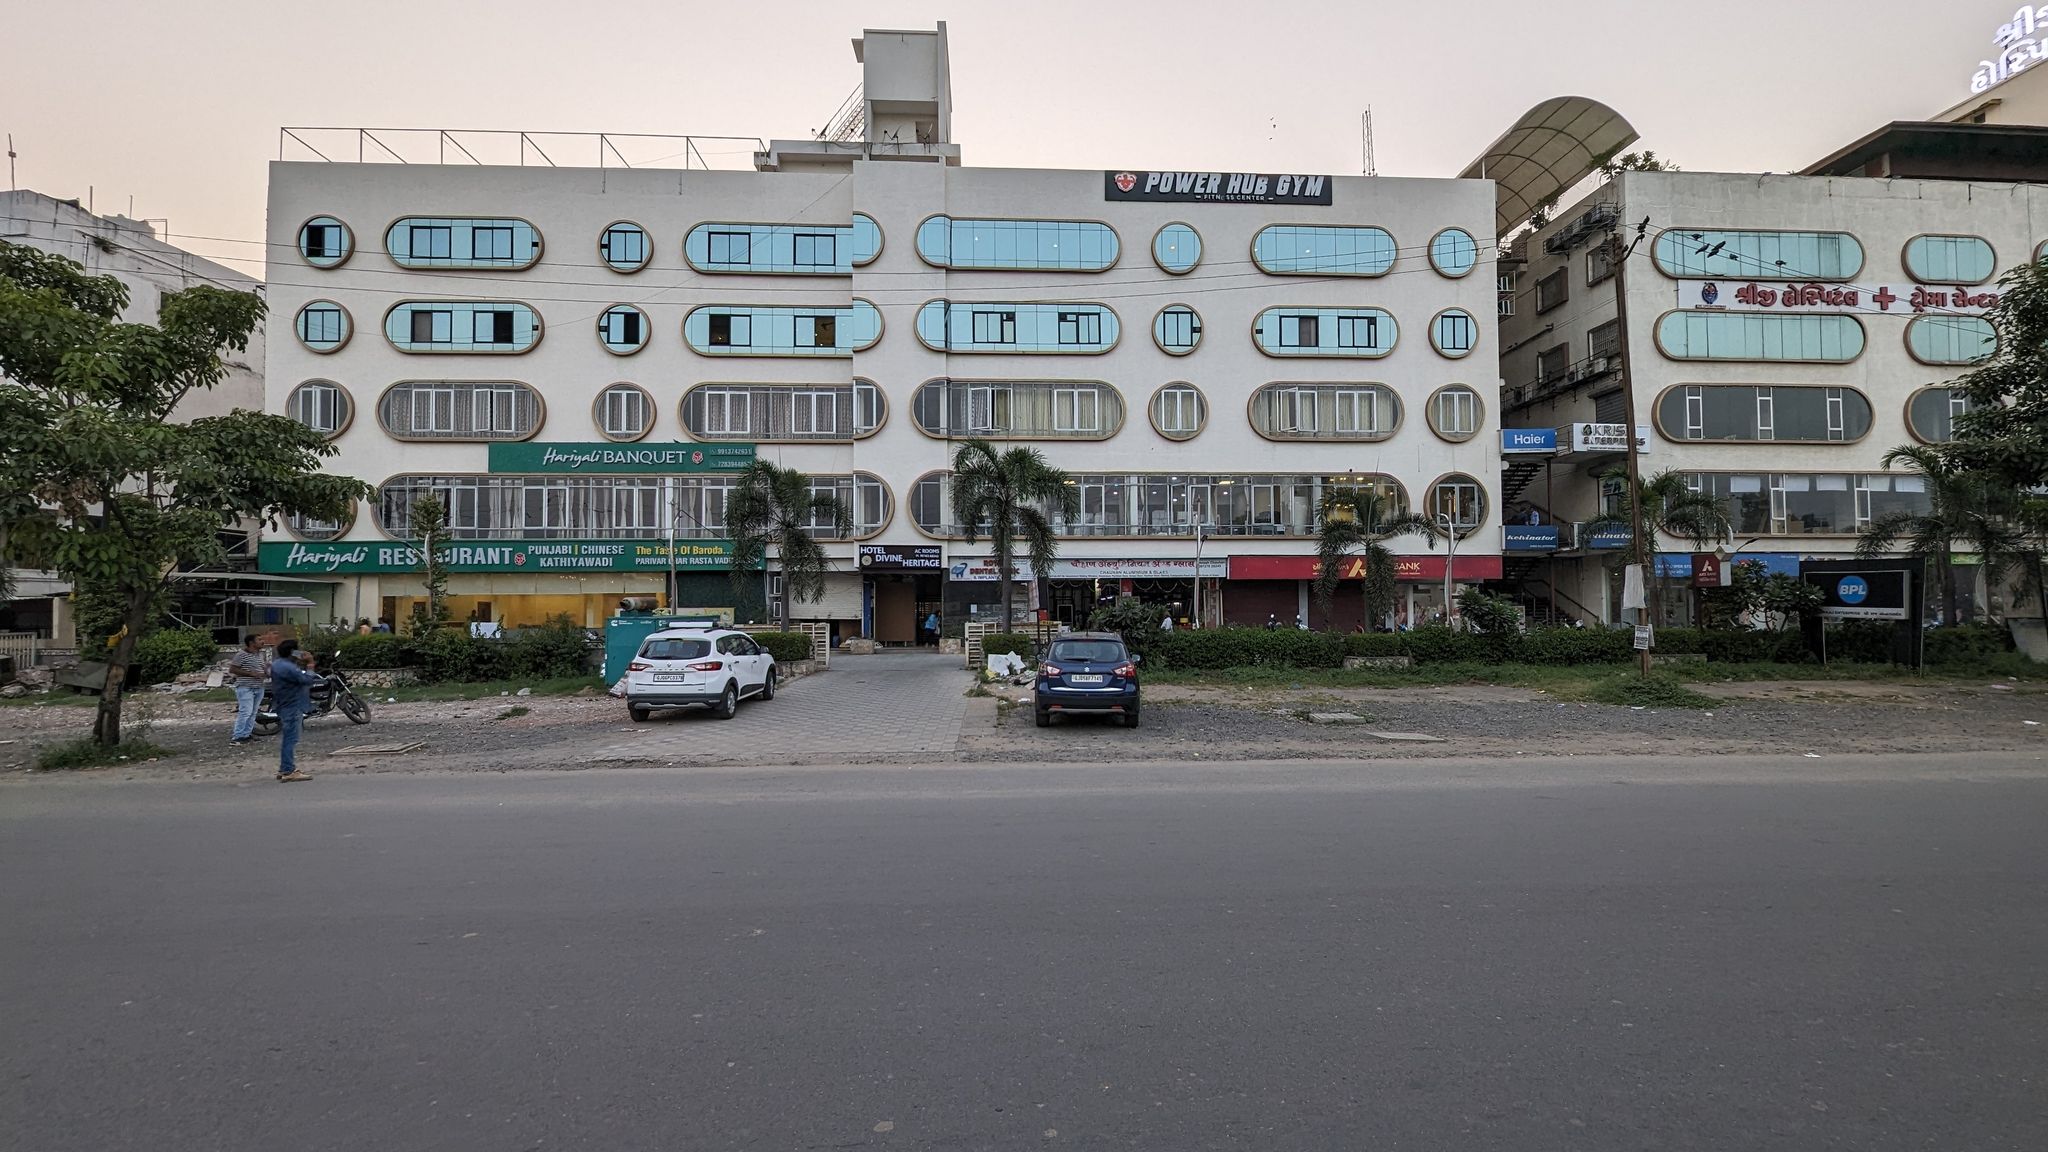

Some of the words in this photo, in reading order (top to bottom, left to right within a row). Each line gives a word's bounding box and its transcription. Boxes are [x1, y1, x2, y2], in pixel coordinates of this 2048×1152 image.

[1145, 172, 1221, 194] POWER
[1227, 174, 1269, 195] HUB
[1276, 176, 1325, 197] GYM
[1514, 434, 1545, 445] Haier
[543, 447, 602, 468] Hariyali
[603, 451, 687, 465] BANQUET
[528, 545, 572, 555] PUNJABI
[581, 545, 624, 555] CHINESE
[636, 546, 651, 555] The
[681, 546, 690, 555] Of
[860, 546, 886, 554] HOTEL
[286, 543, 369, 571] Hariyali
[379, 547, 513, 566] RESURANT
[540, 557, 613, 567] KATHIYAWADI
[875, 554, 902, 562] DIVINE
[902, 559, 940, 567] HERITAGE
[1839, 585, 1866, 594] BPL
